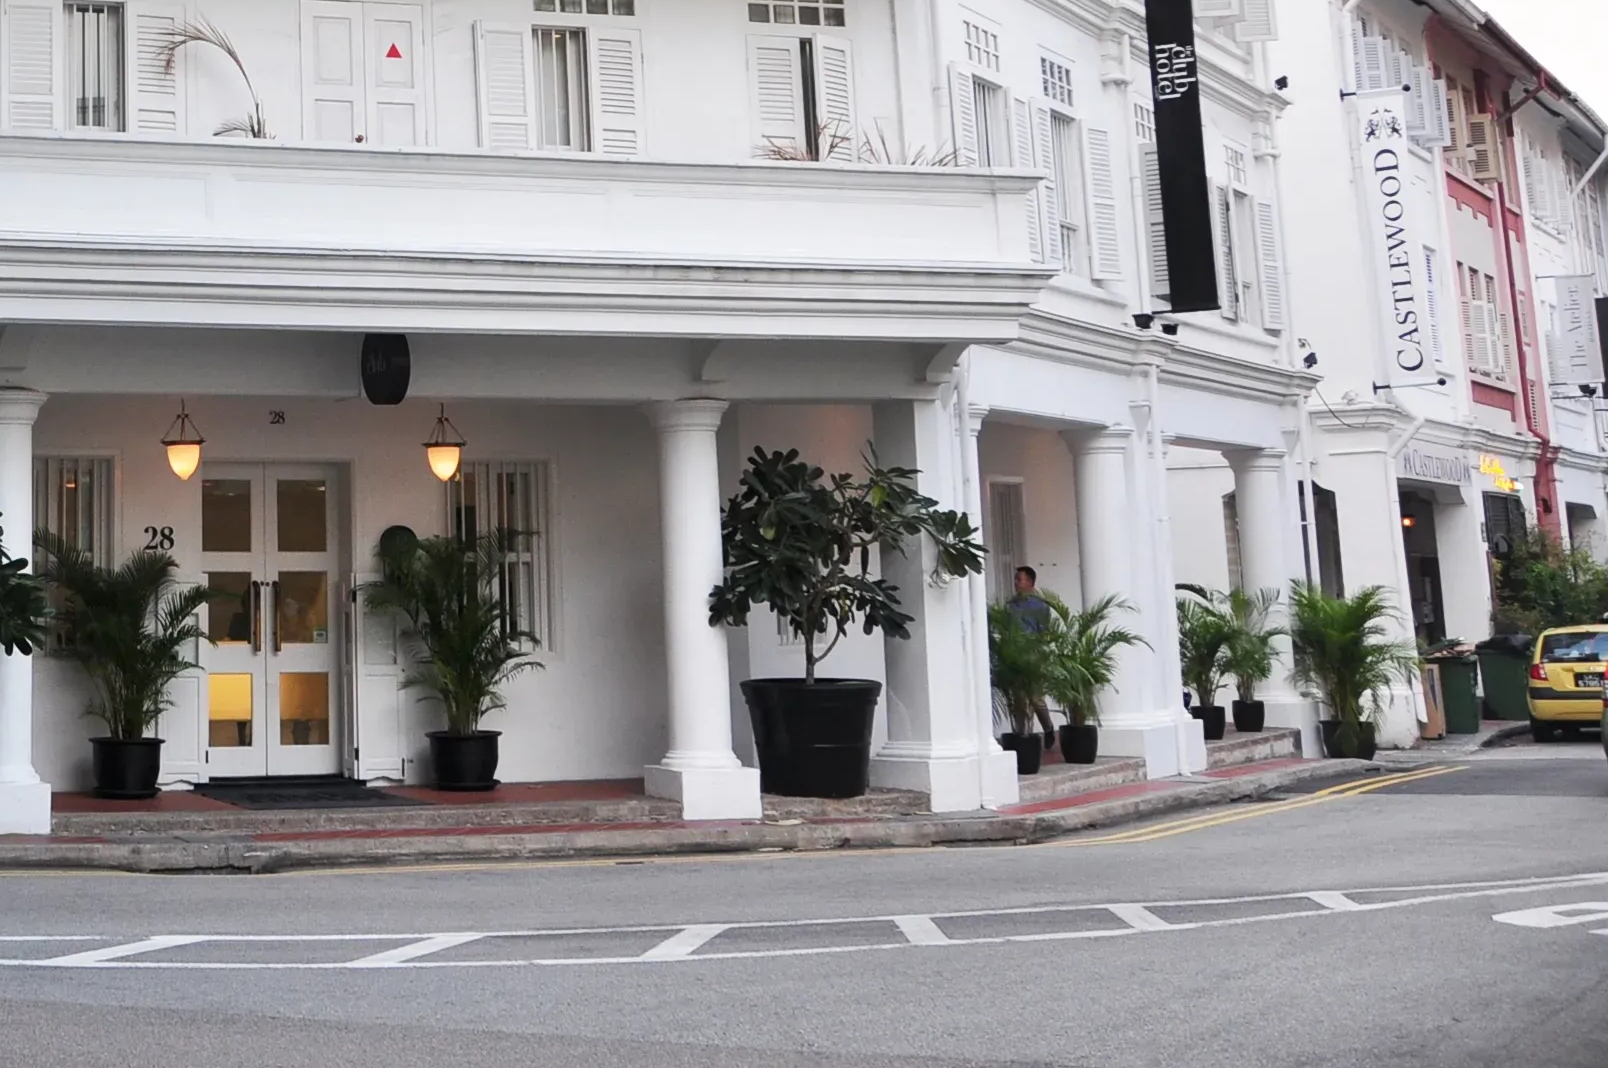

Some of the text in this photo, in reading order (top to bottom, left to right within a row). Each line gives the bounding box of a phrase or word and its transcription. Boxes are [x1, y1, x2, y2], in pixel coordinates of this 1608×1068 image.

[1155, 43, 1182, 100] hotel
[1171, 46, 1197, 92] club
[1373, 148, 1424, 372] CASTLEWOOD
[1569, 340, 1588, 373] The
[269, 410, 286, 425] 28
[143, 525, 174, 551] 28
